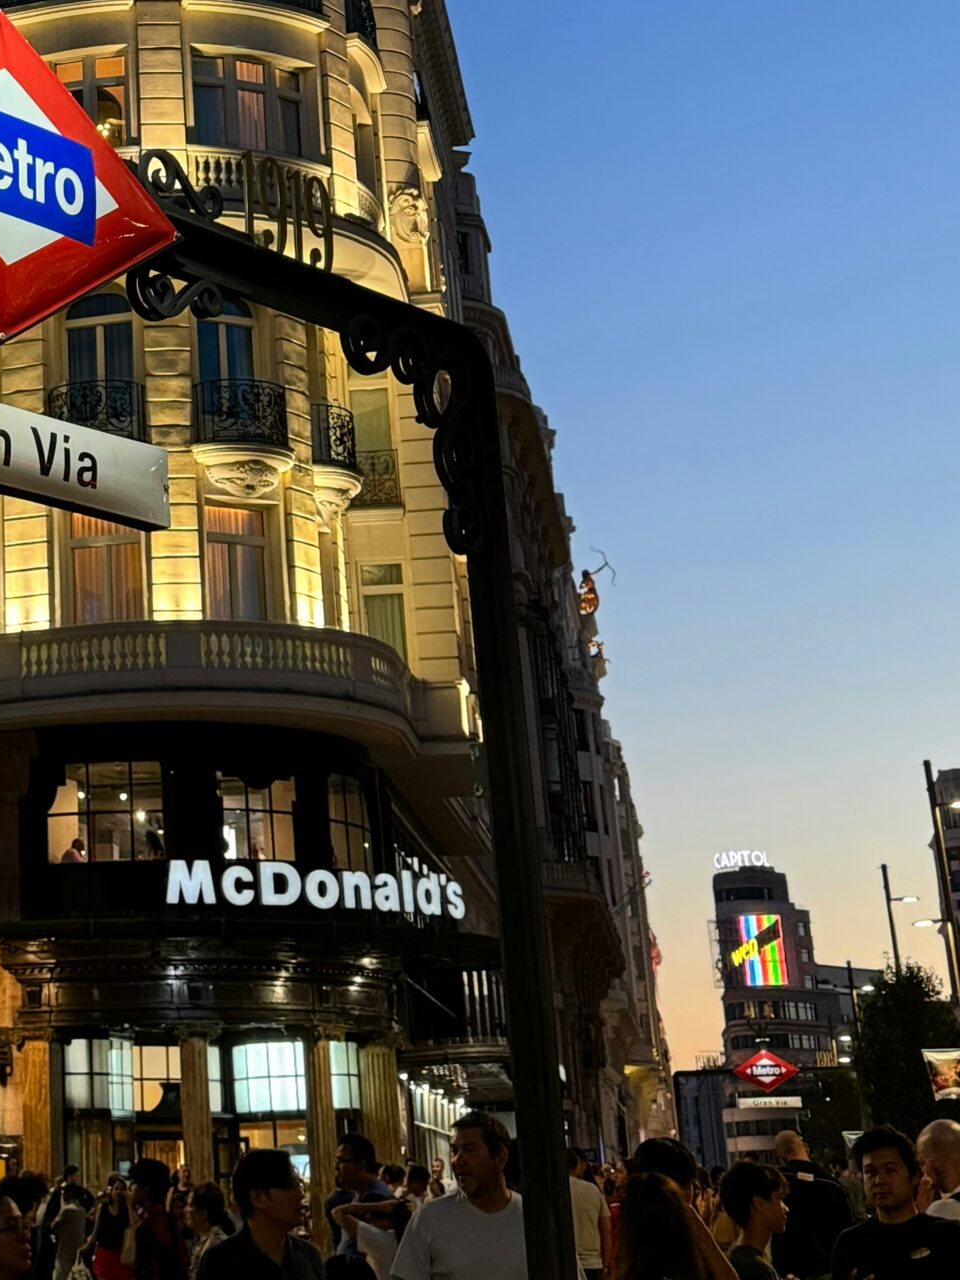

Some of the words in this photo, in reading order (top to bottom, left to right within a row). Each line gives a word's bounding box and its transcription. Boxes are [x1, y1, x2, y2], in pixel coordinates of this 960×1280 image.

[241, 149, 333, 272] 1919
[714, 851, 770, 868] CAPITOL
[166, 858, 467, 920] McDonald's
[752, 1065, 781, 1075] Metro
